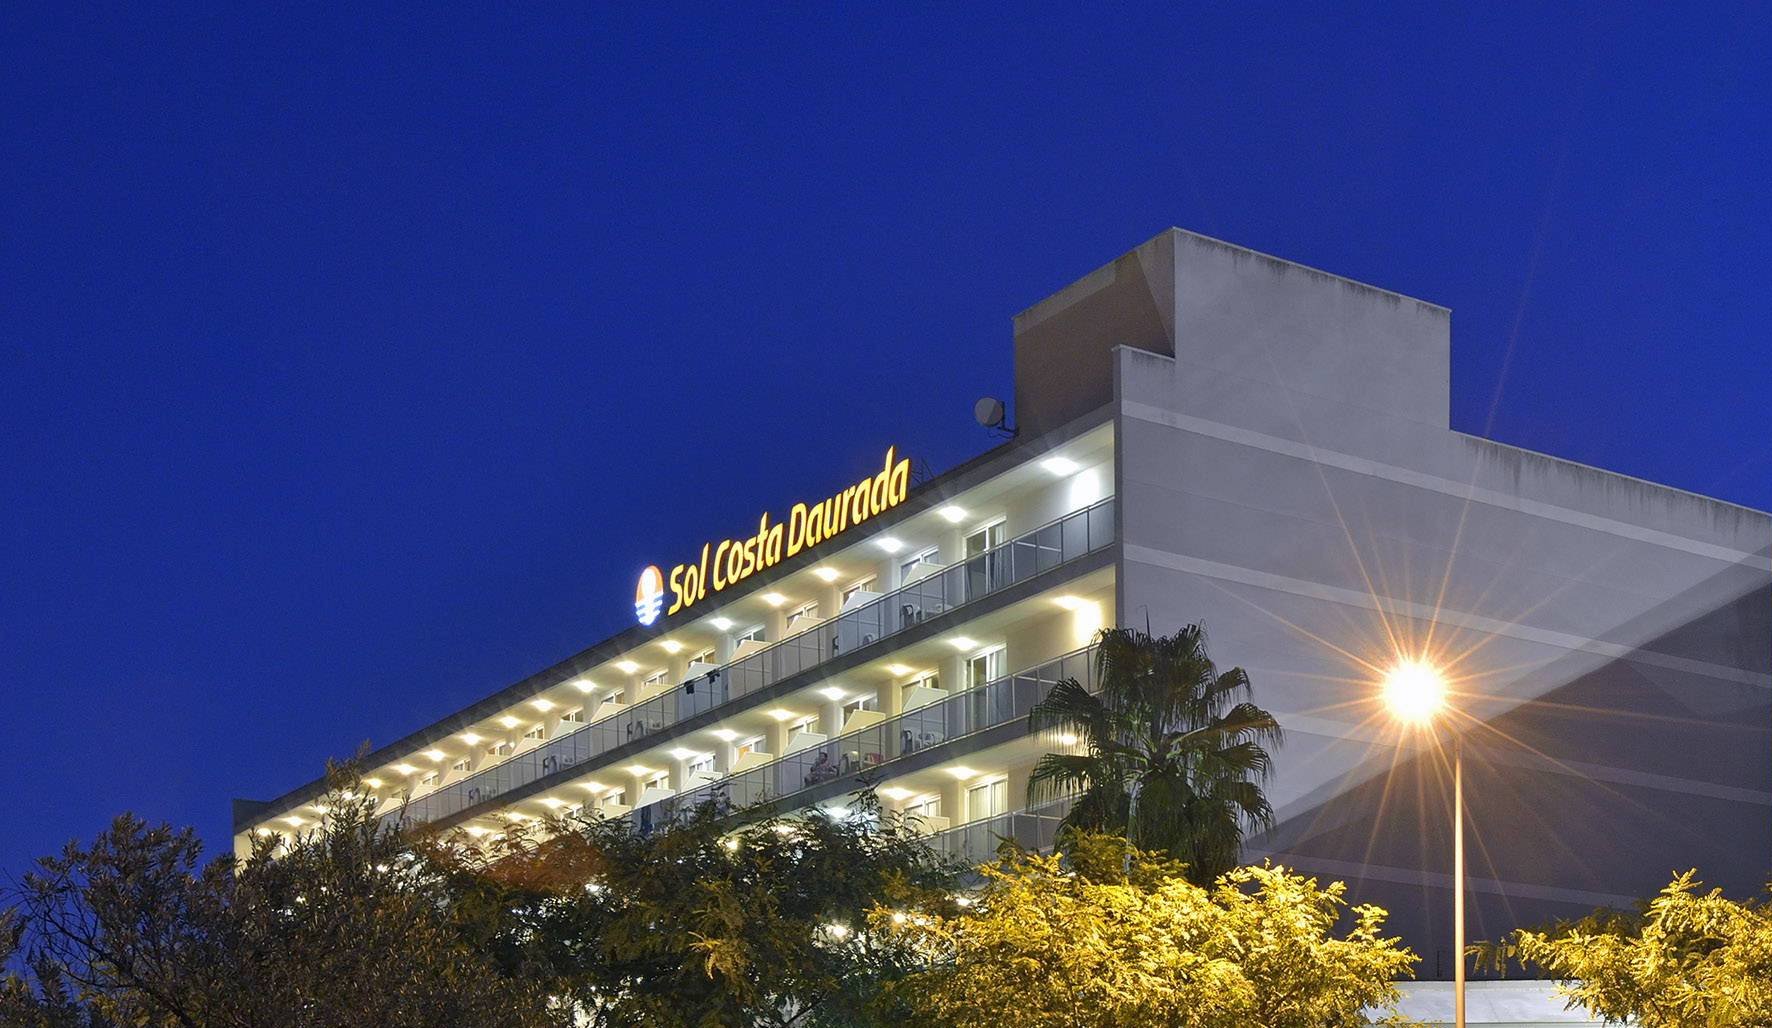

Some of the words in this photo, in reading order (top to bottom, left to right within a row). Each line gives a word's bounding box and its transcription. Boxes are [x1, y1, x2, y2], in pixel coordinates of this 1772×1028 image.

[667, 542, 710, 616] Sol
[712, 511, 783, 591] Costa
[787, 445, 911, 558] Daurada
